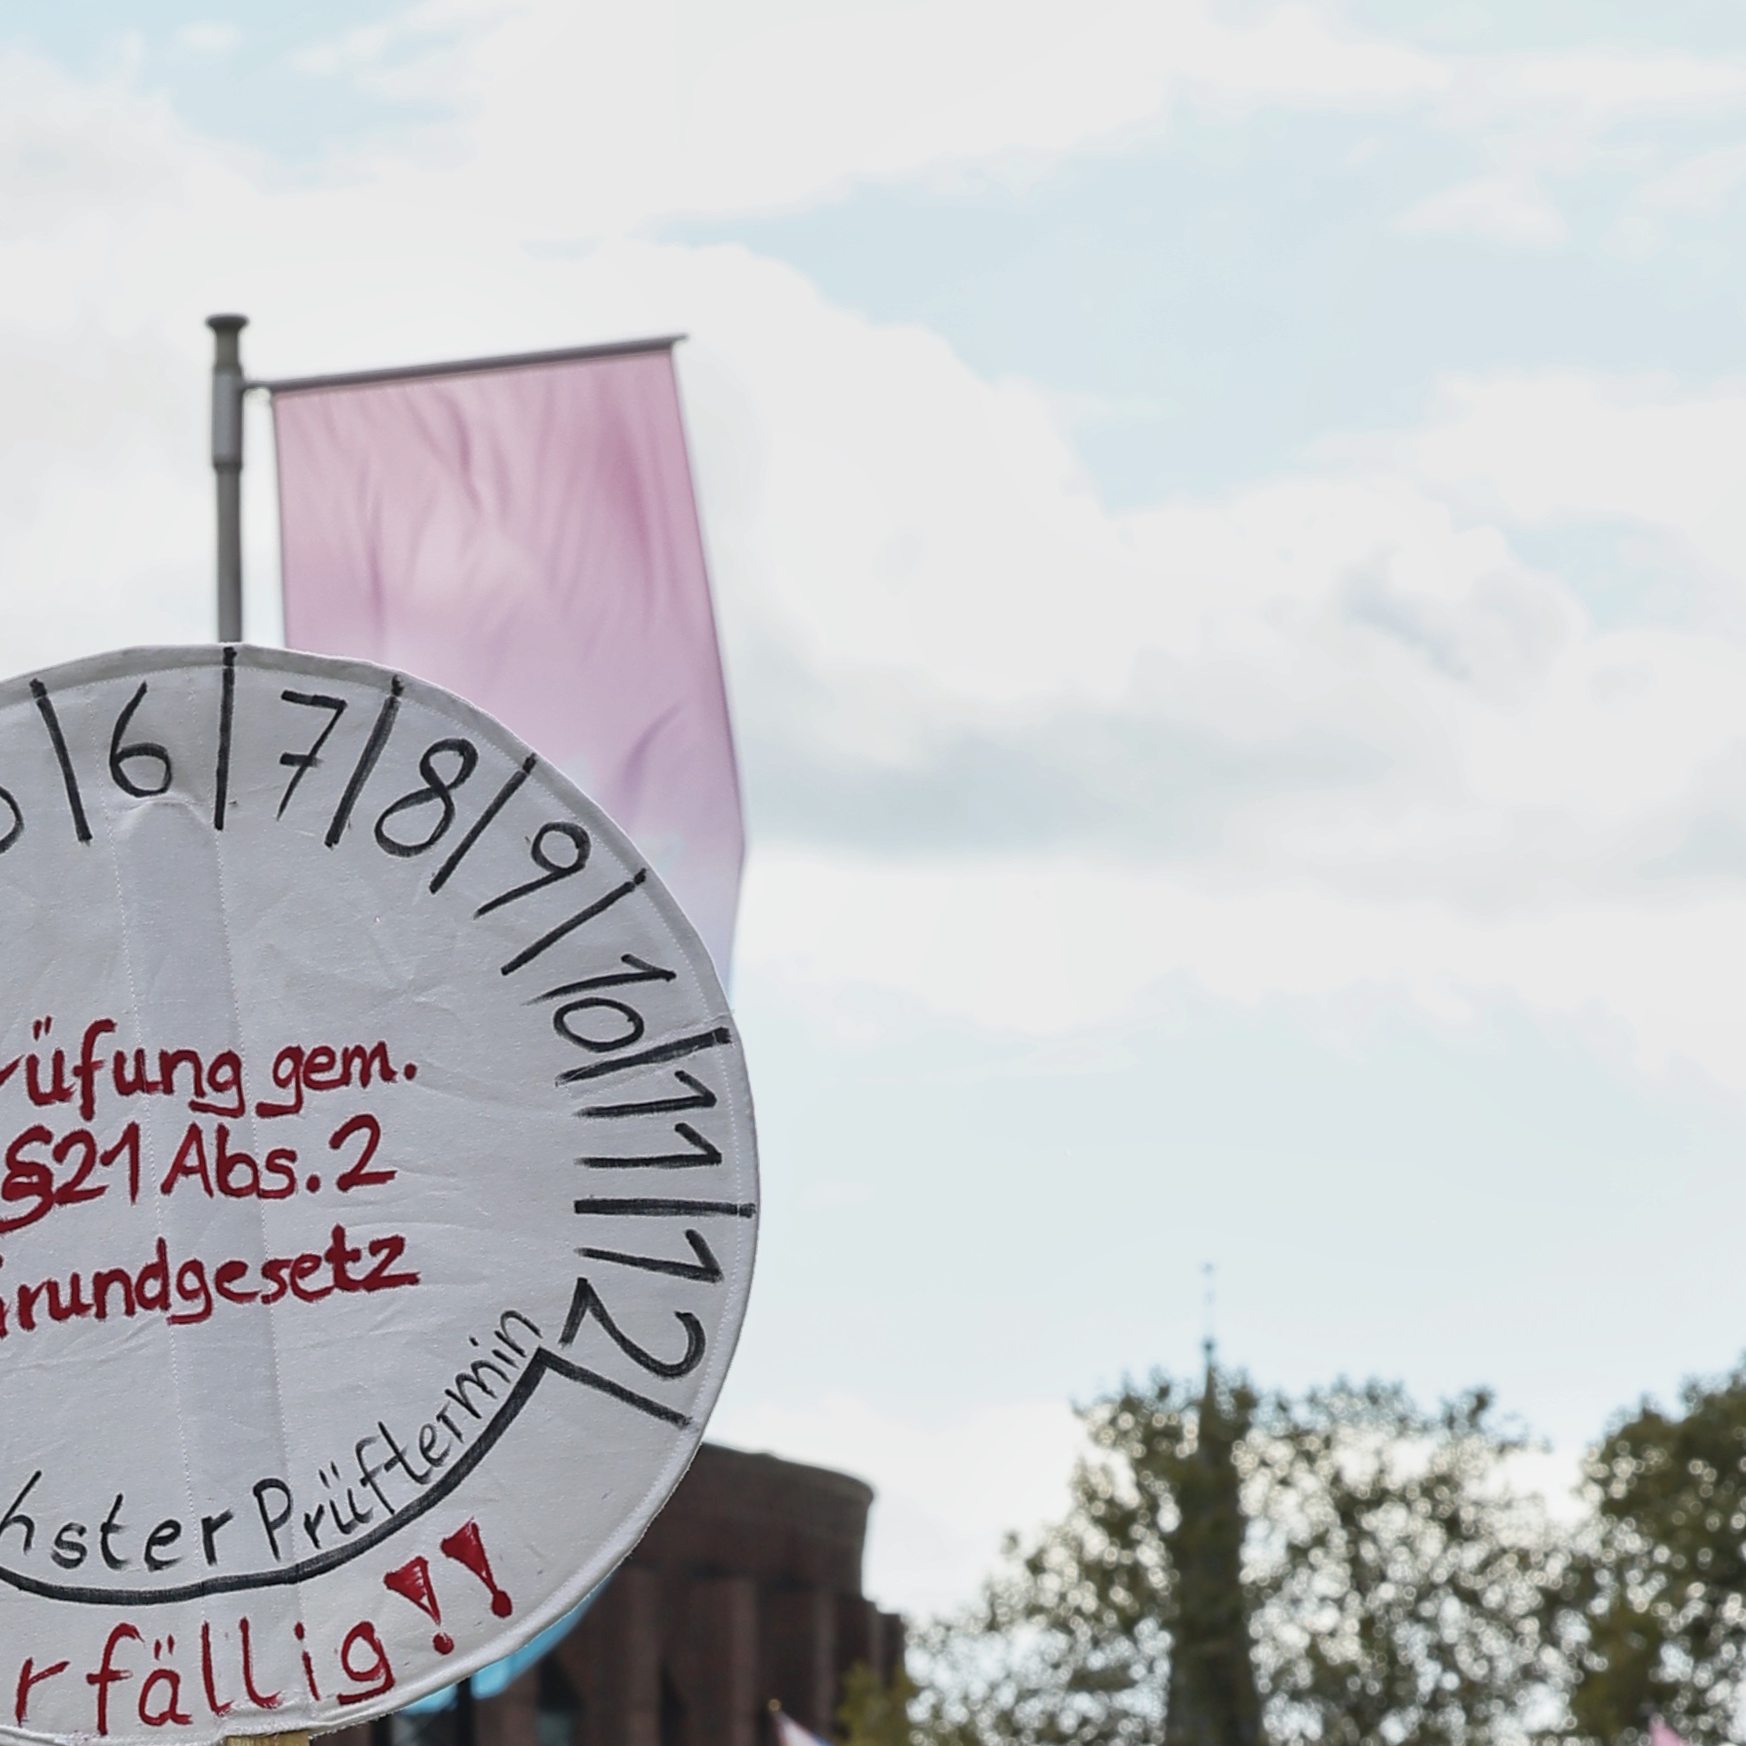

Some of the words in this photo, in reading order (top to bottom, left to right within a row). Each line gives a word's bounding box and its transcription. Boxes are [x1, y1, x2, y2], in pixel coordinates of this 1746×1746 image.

[108, 681, 175, 798] 6
[276, 690, 348, 819] 7
[374, 738, 479, 857] 8
[474, 823, 591, 918] 9
[534, 954, 676, 1053] 10
[254, 1043, 416, 1118] gem.
[575, 1070, 724, 1169] 11
[559, 1229, 724, 1380] 12
[253, 1310, 542, 1561] Prüftermin
